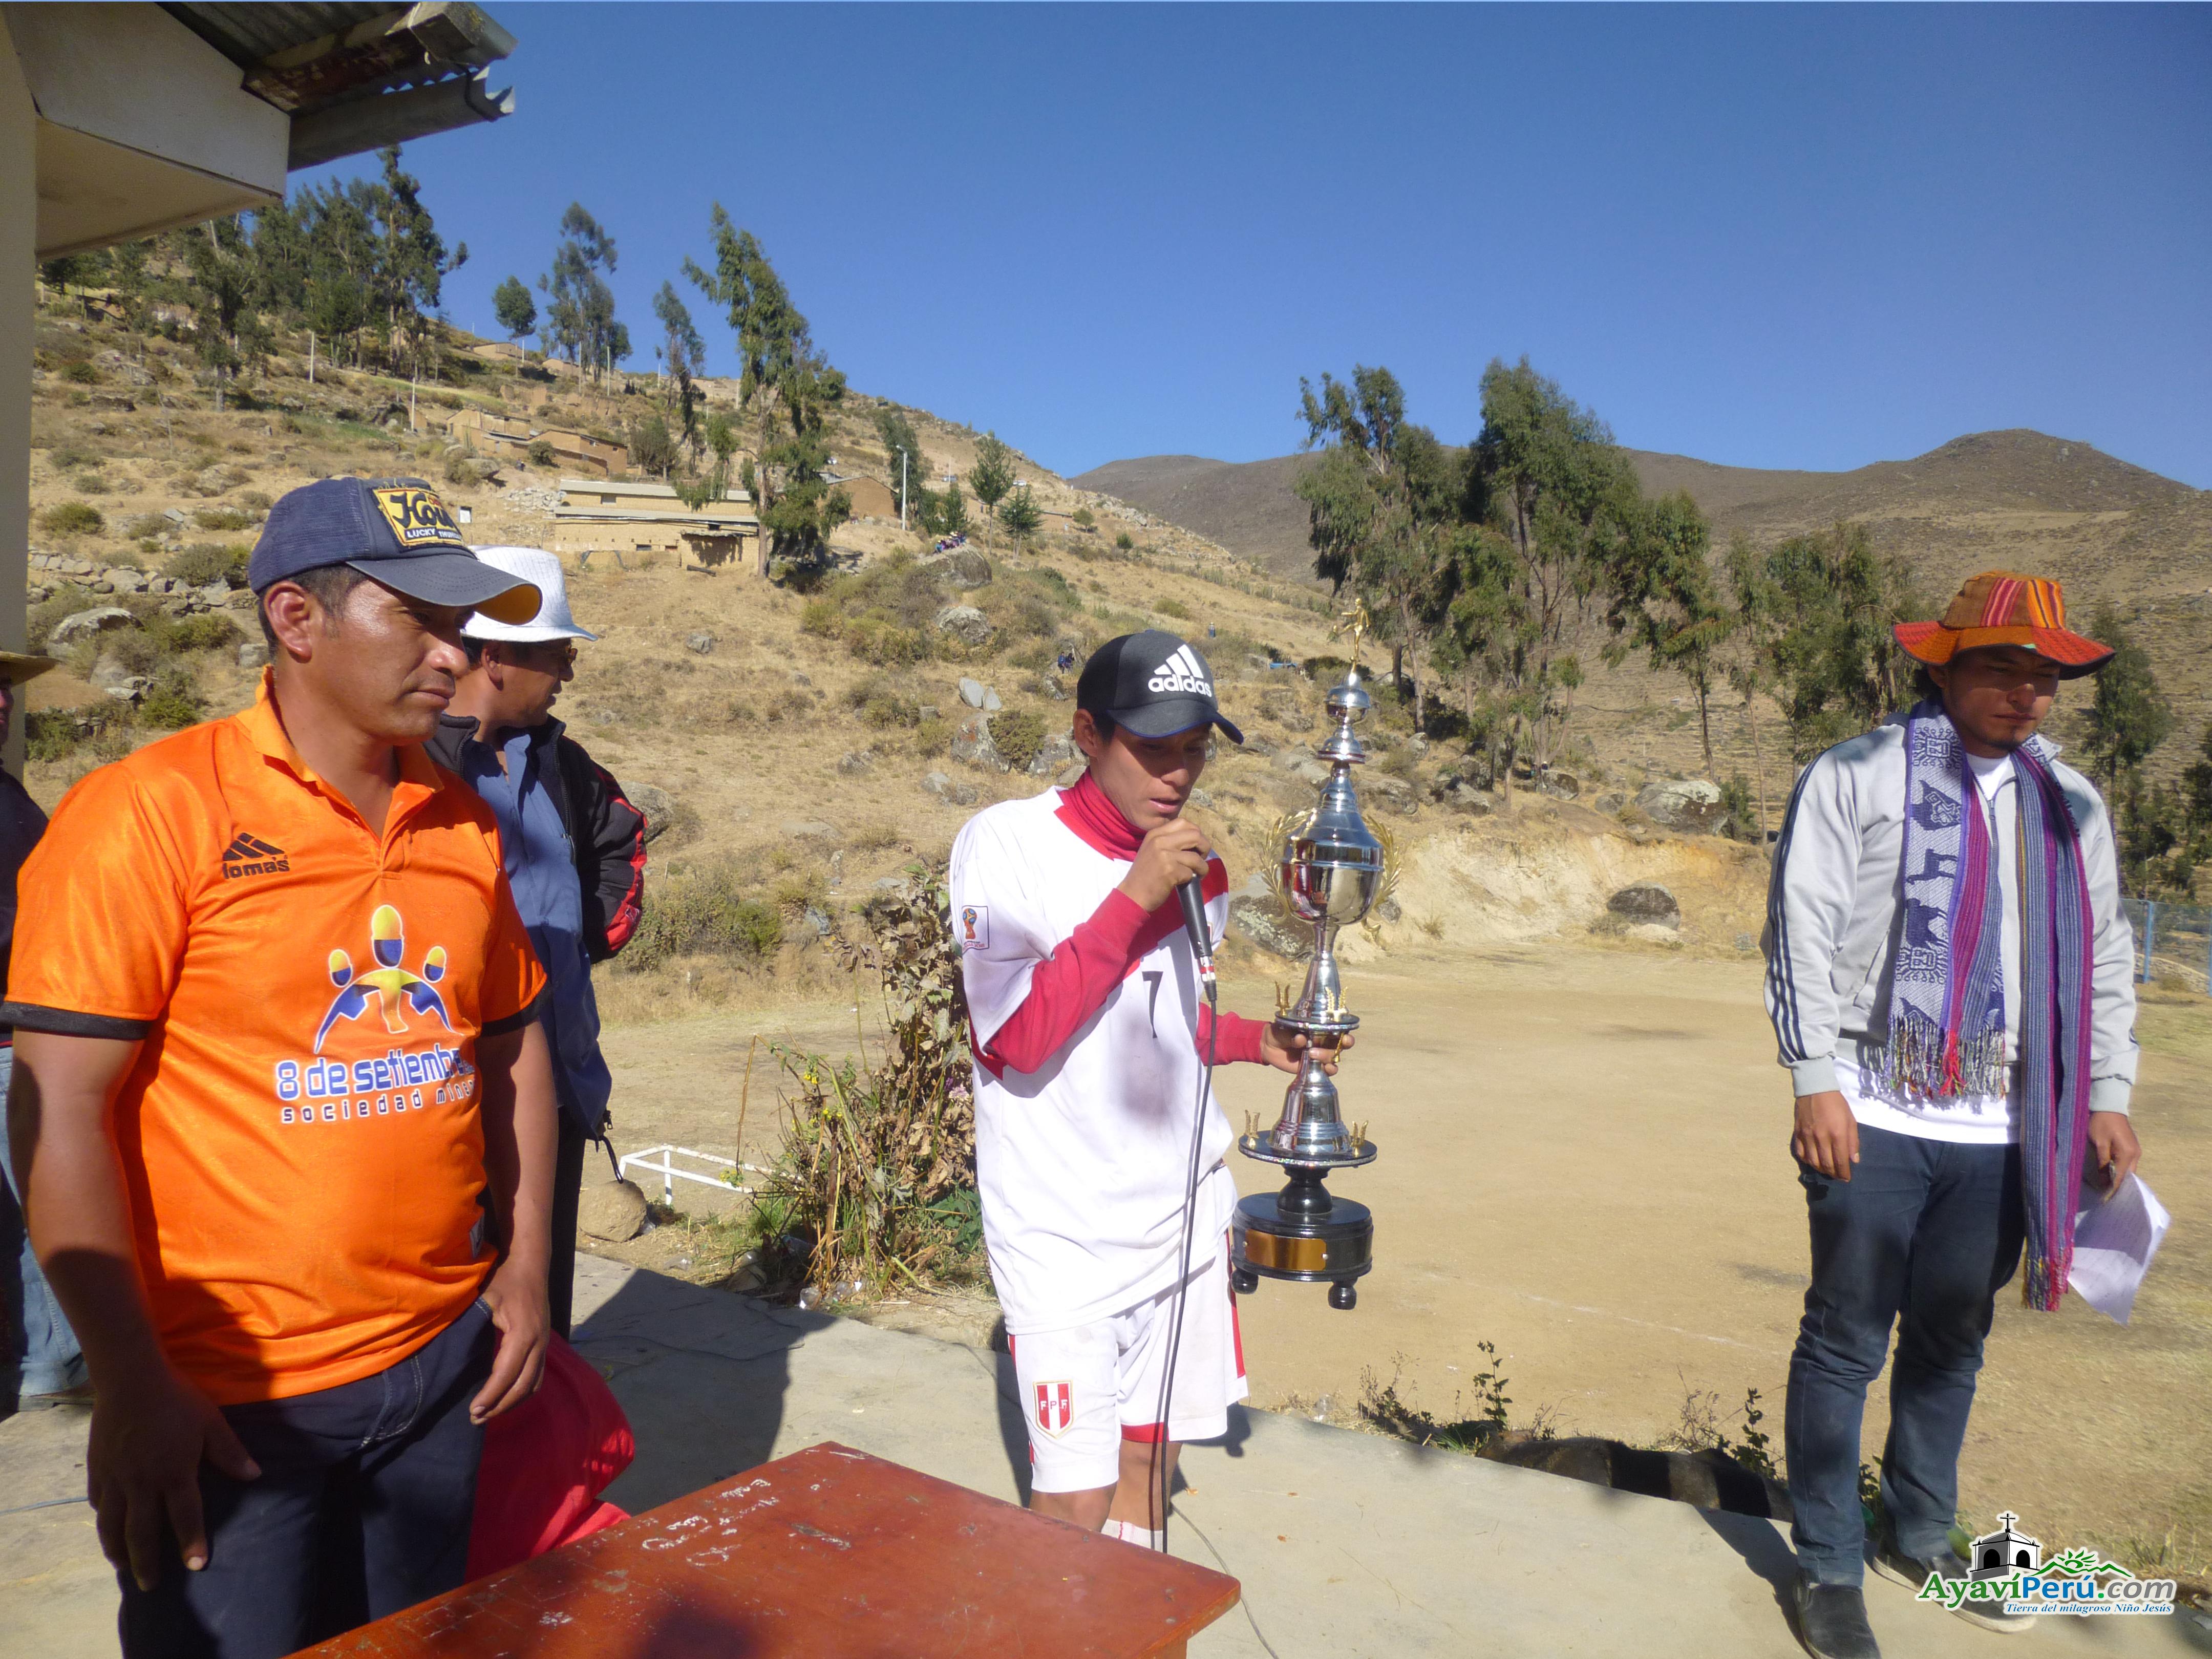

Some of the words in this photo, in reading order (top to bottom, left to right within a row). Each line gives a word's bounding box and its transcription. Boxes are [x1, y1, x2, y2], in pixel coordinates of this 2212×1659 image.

[406, 528, 436, 538] LUCKY
[1148, 674, 1212, 697] adidas
[1141, 971, 1164, 1038] 7
[275, 1060, 300, 1101] 8
[306, 1057, 348, 1097] de
[282, 1090, 422, 1124] sociedad
